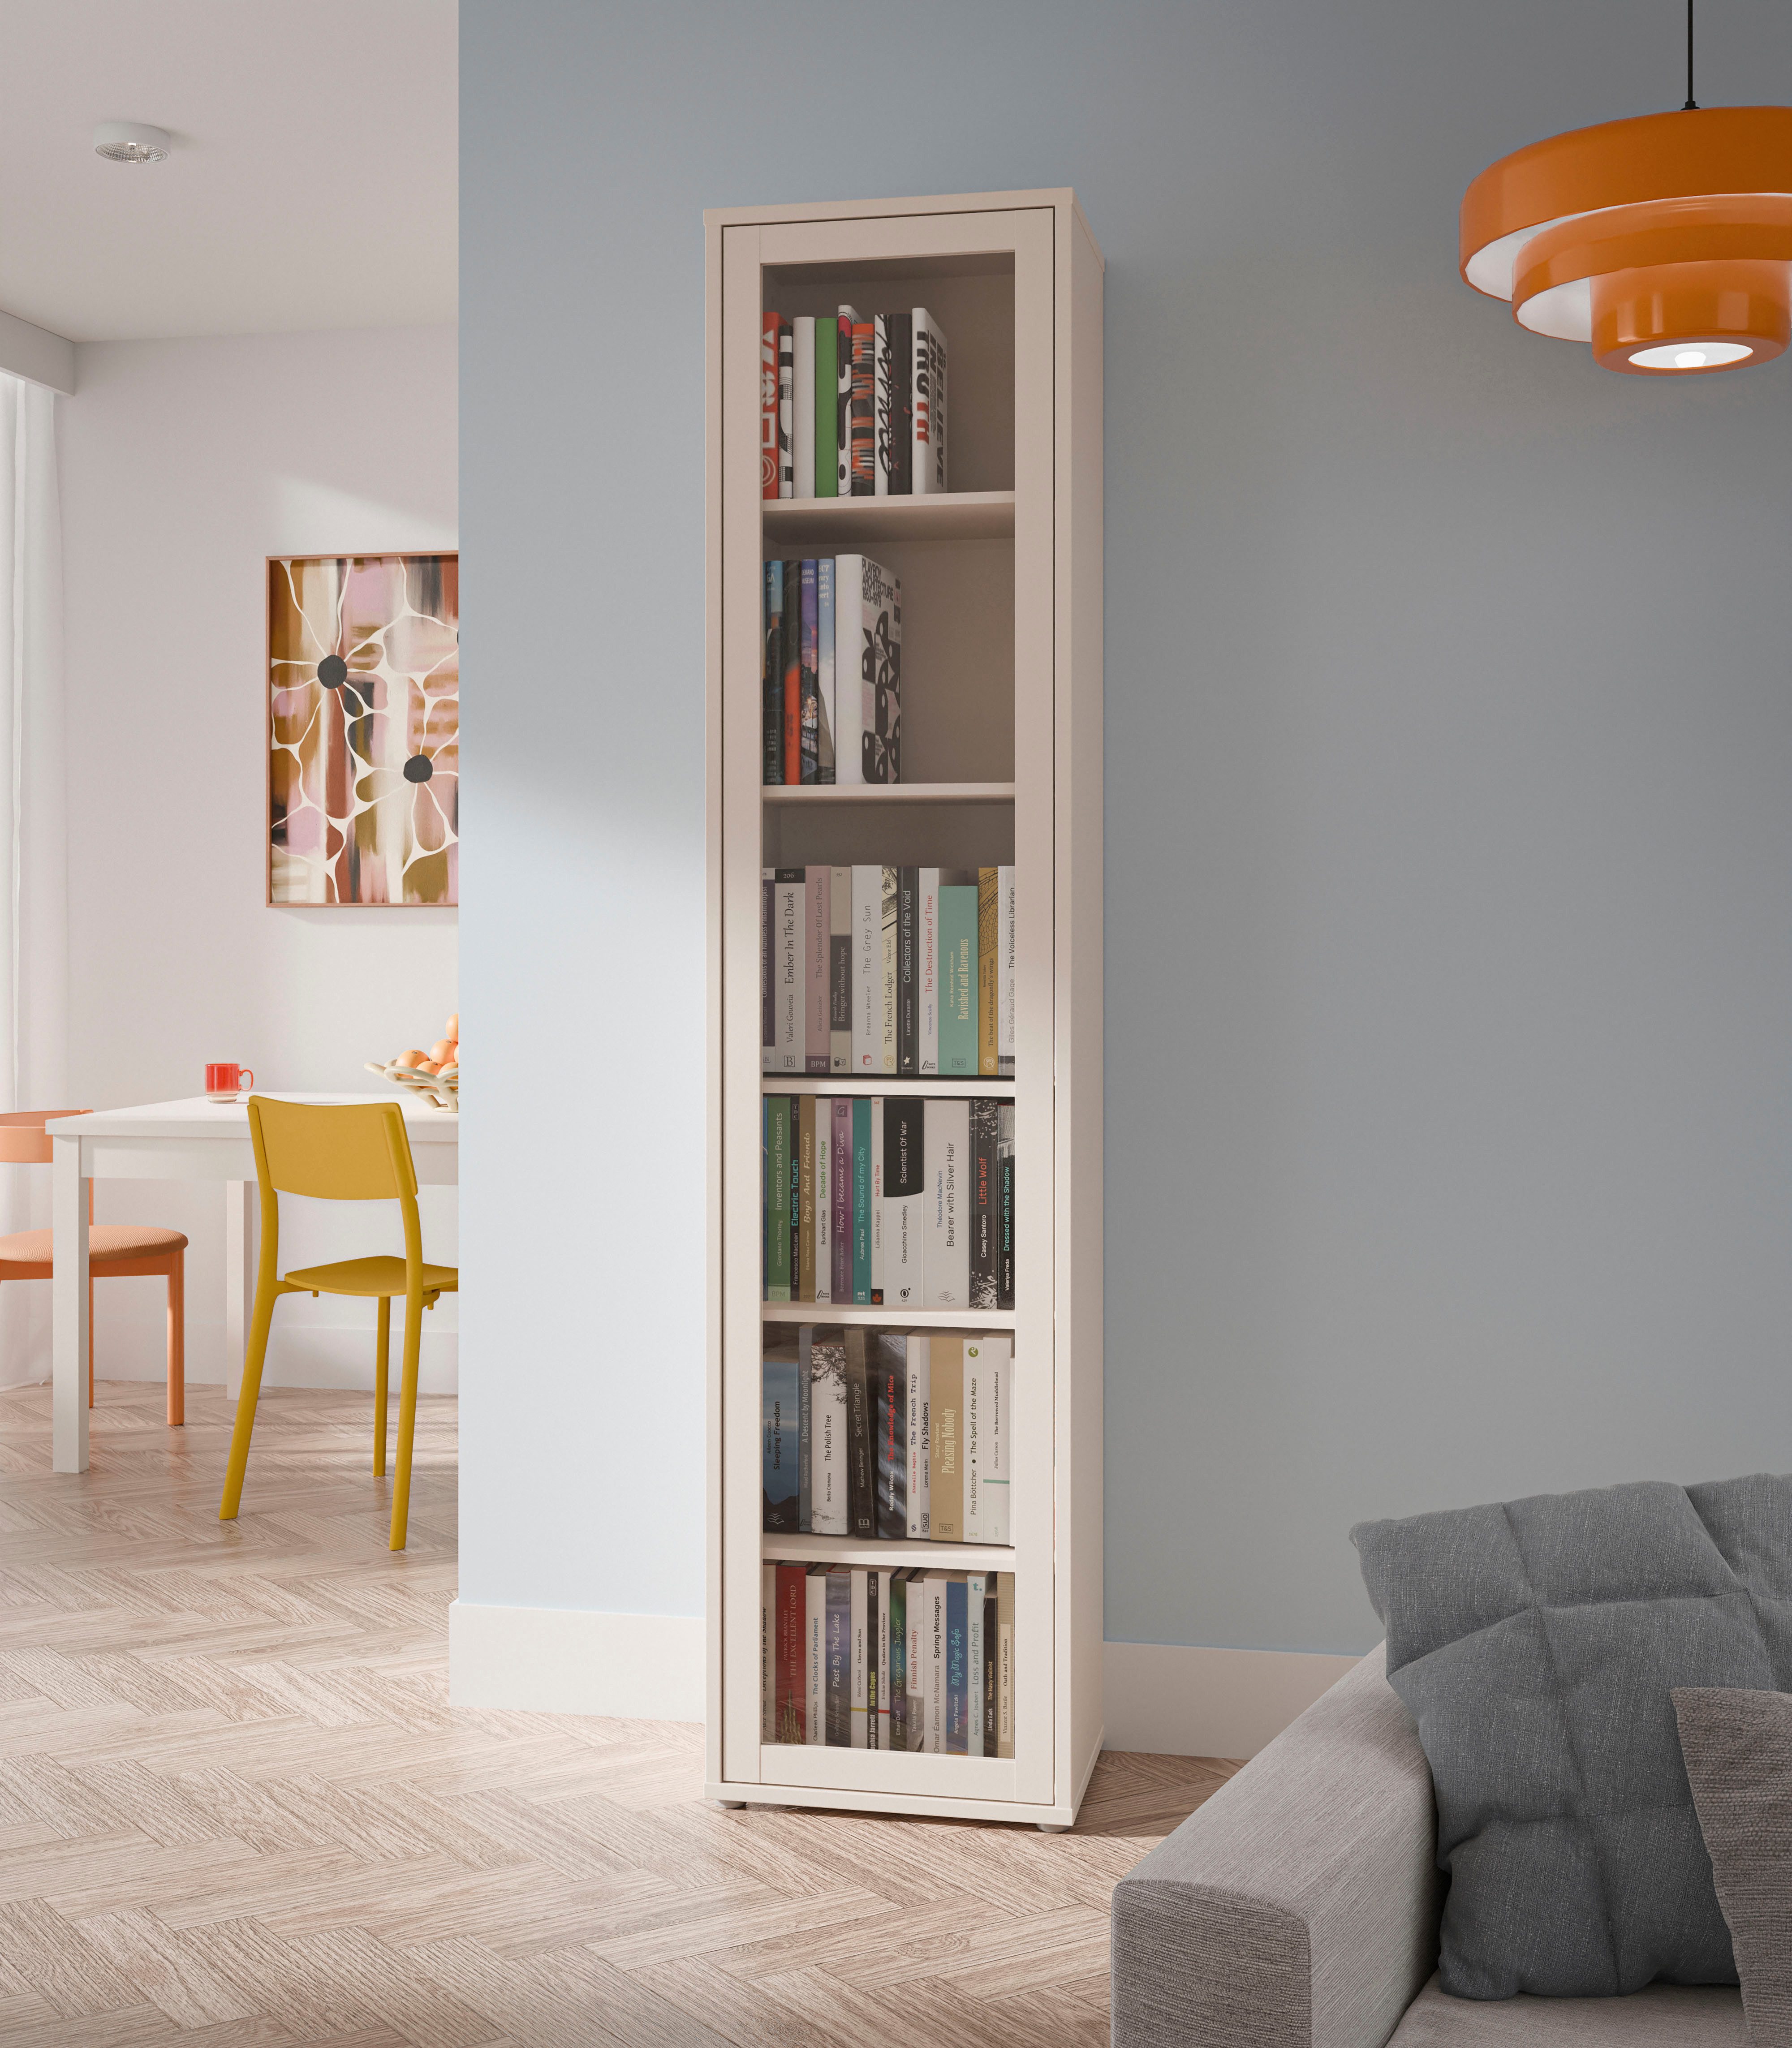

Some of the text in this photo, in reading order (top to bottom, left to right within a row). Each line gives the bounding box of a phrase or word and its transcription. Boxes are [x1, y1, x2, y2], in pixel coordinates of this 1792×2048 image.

[930, 332, 936, 374] IN
[916, 329, 929, 445] TRUTH
[816, 919, 822, 928] Of
[925, 917, 932, 925] of
[784, 892, 793, 984] Ember In The Dark
[863, 929, 872, 951] Grey
[903, 929, 910, 937] of
[839, 947, 847, 964] hope
[885, 972, 894, 998] Lodger
[958, 939, 968, 1019] Ravished and Ravenous
[839, 996, 847, 1021] Bringer
[786, 1056, 793, 1066] B
[900, 1137, 907, 1146] Of
[820, 1162, 825, 1170] of
[860, 1162, 865, 1174] my
[791, 1192, 799, 1227] Electric
[887, 1404, 896, 1446] Knowledge
[942, 1409, 956, 1473] Pleasing Nobody
[833, 1655, 841, 1666] By
[951, 1629, 962, 1686] My Magic Sofa
